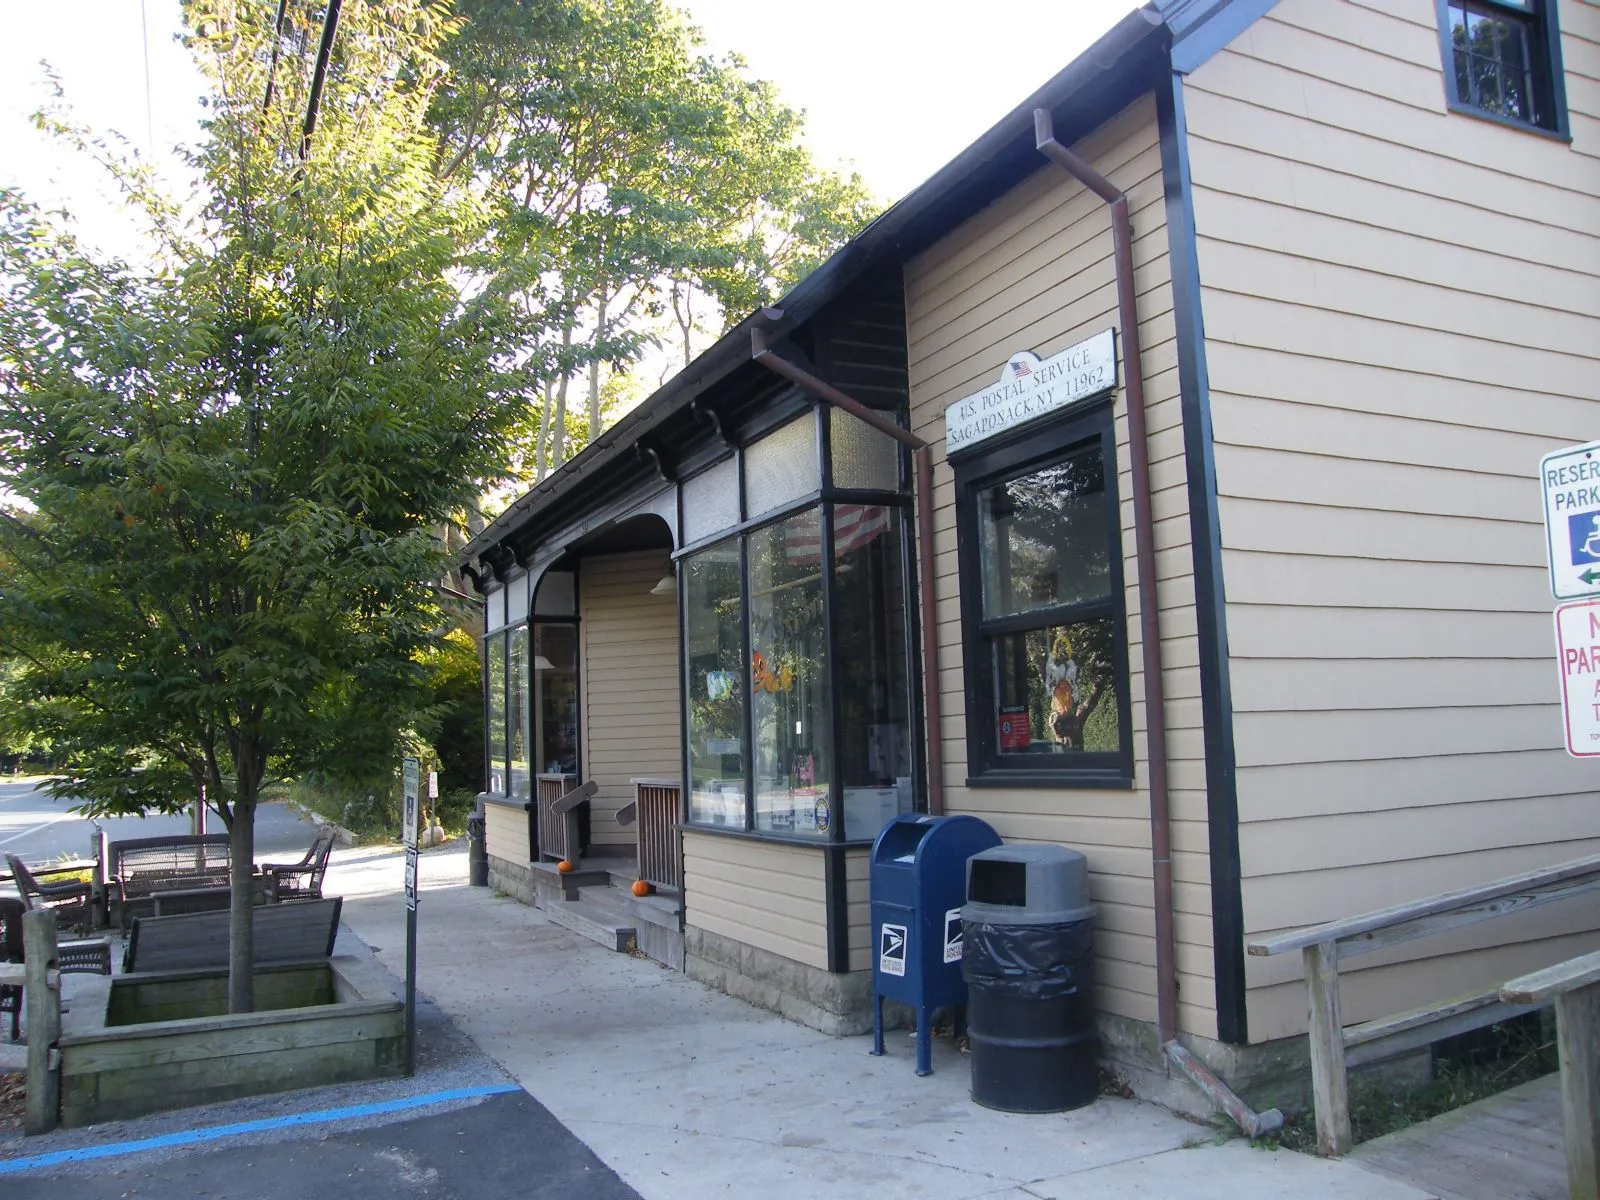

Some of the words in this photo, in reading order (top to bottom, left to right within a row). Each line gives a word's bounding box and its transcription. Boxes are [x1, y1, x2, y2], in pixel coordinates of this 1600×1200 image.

[960, 401, 977, 420] U.S.
[983, 380, 1025, 410] POSTAL
[1033, 348, 1090, 387] SERVICE
[1066, 366, 1104, 396] 11962
